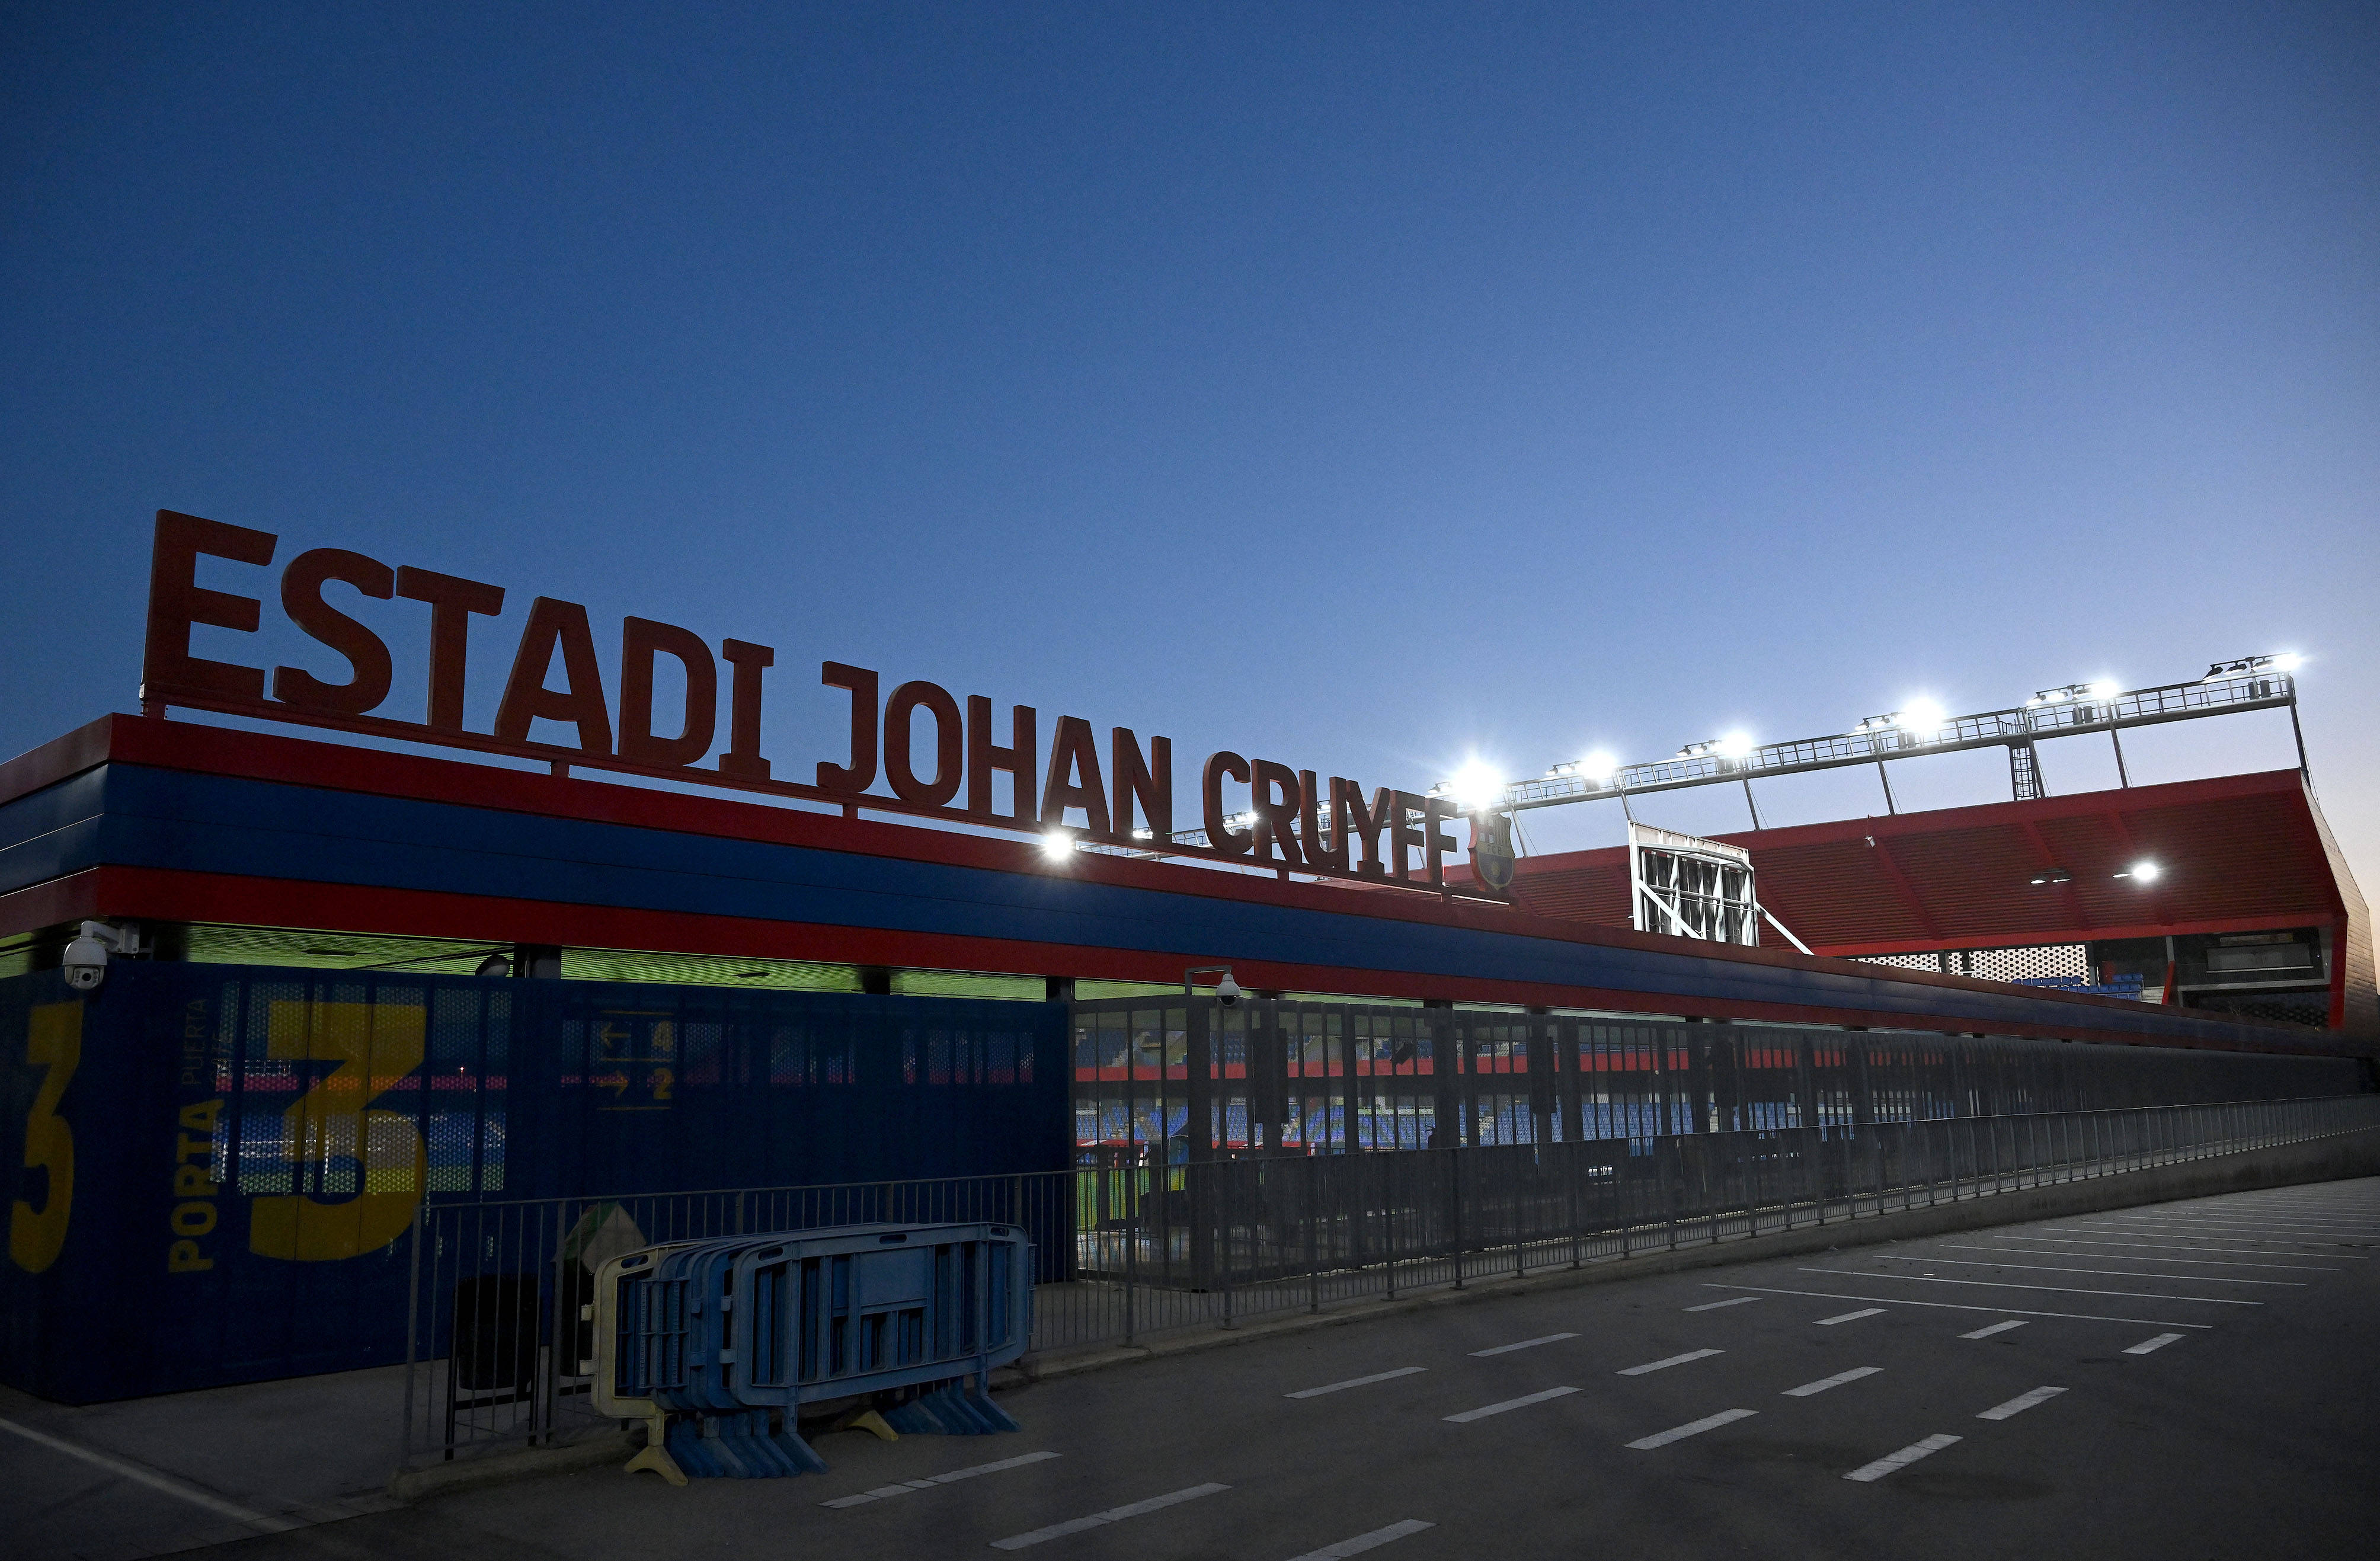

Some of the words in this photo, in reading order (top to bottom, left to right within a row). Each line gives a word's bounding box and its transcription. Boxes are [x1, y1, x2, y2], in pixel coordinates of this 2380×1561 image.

[143, 508, 774, 781] ESTADI
[817, 660, 1172, 844] JOHAN
[1202, 750, 1458, 884] CRUYFF
[181, 998, 207, 1085] PUERTA
[651, 1020, 674, 1053] 4
[652, 1067, 675, 1101] 2
[8, 999, 85, 1274] 3
[168, 1098, 225, 1274] PORTA
[249, 1000, 428, 1261] 3
